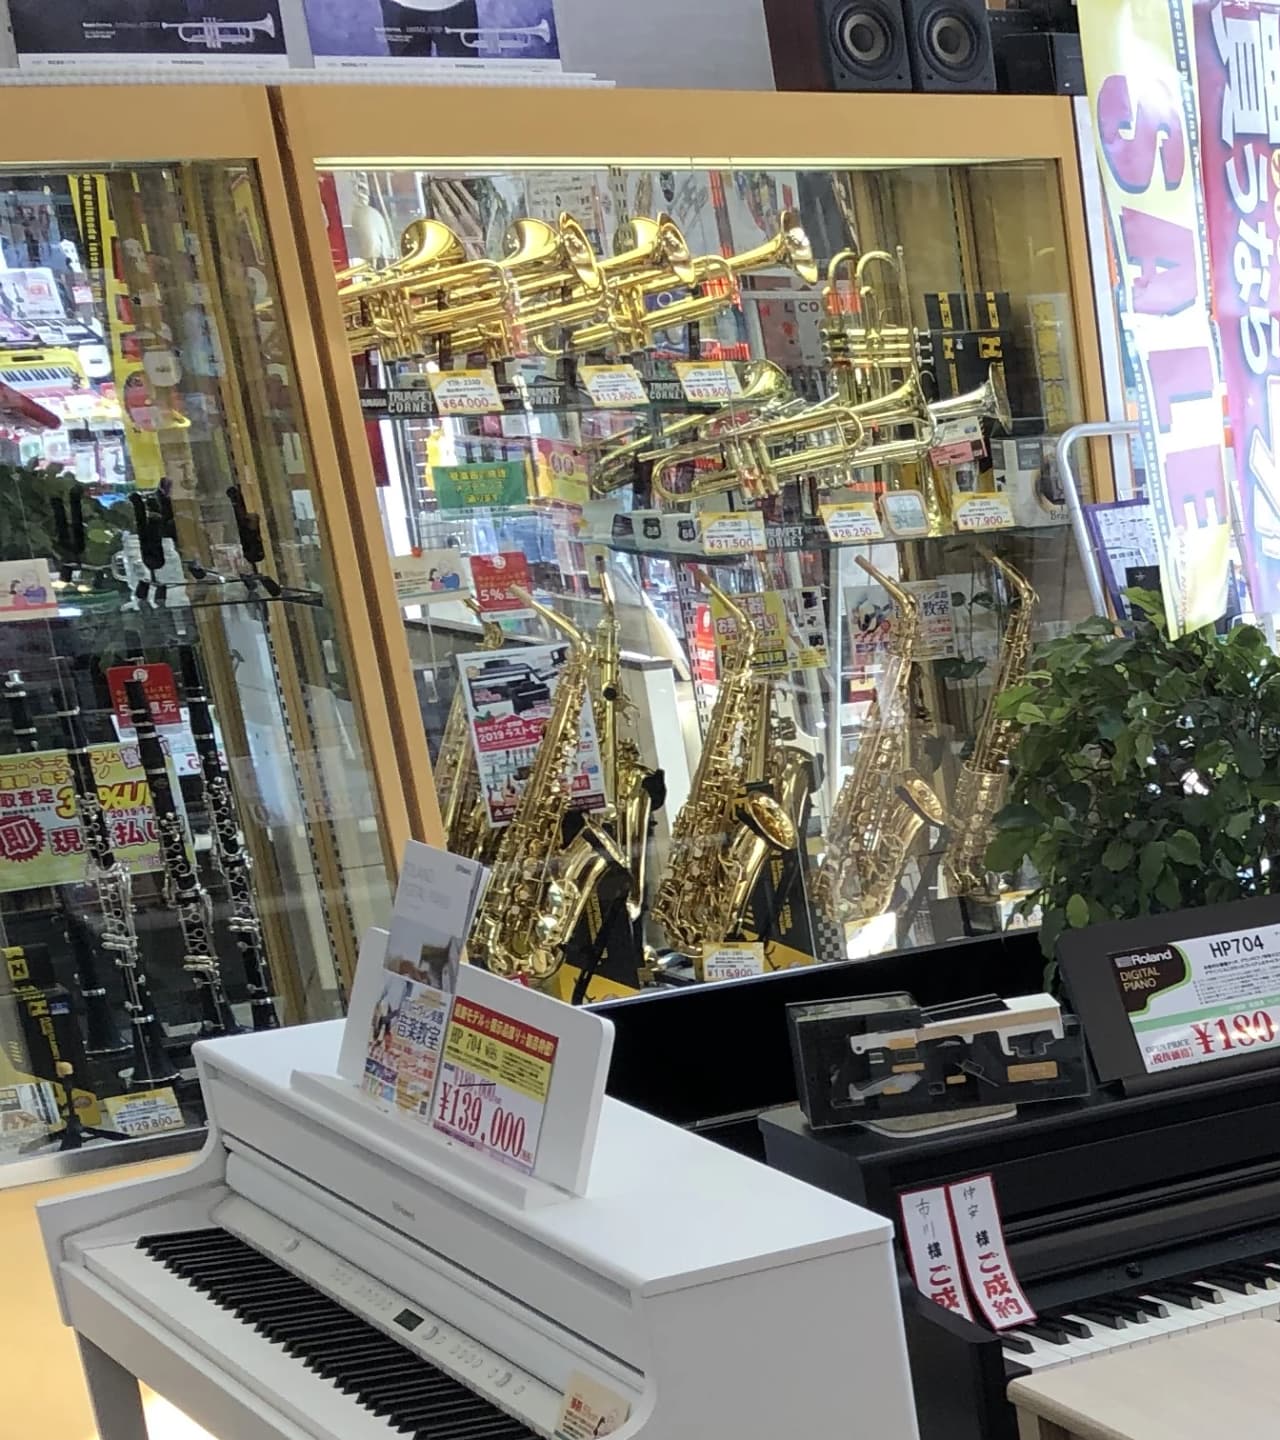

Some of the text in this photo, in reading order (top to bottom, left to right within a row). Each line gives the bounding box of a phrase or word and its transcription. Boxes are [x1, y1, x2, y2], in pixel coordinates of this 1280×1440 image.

[1097, 74, 1229, 529] SALE
[387, 401, 435, 414] CORNET
[1208, 933, 1265, 959] HP704
[1130, 949, 1173, 968] Roland
[1118, 965, 1161, 982] DIGITAL
[1122, 977, 1158, 993] PIANO
[974, 1229, 992, 1249] 様
[976, 1250, 1025, 1320] ご成約
